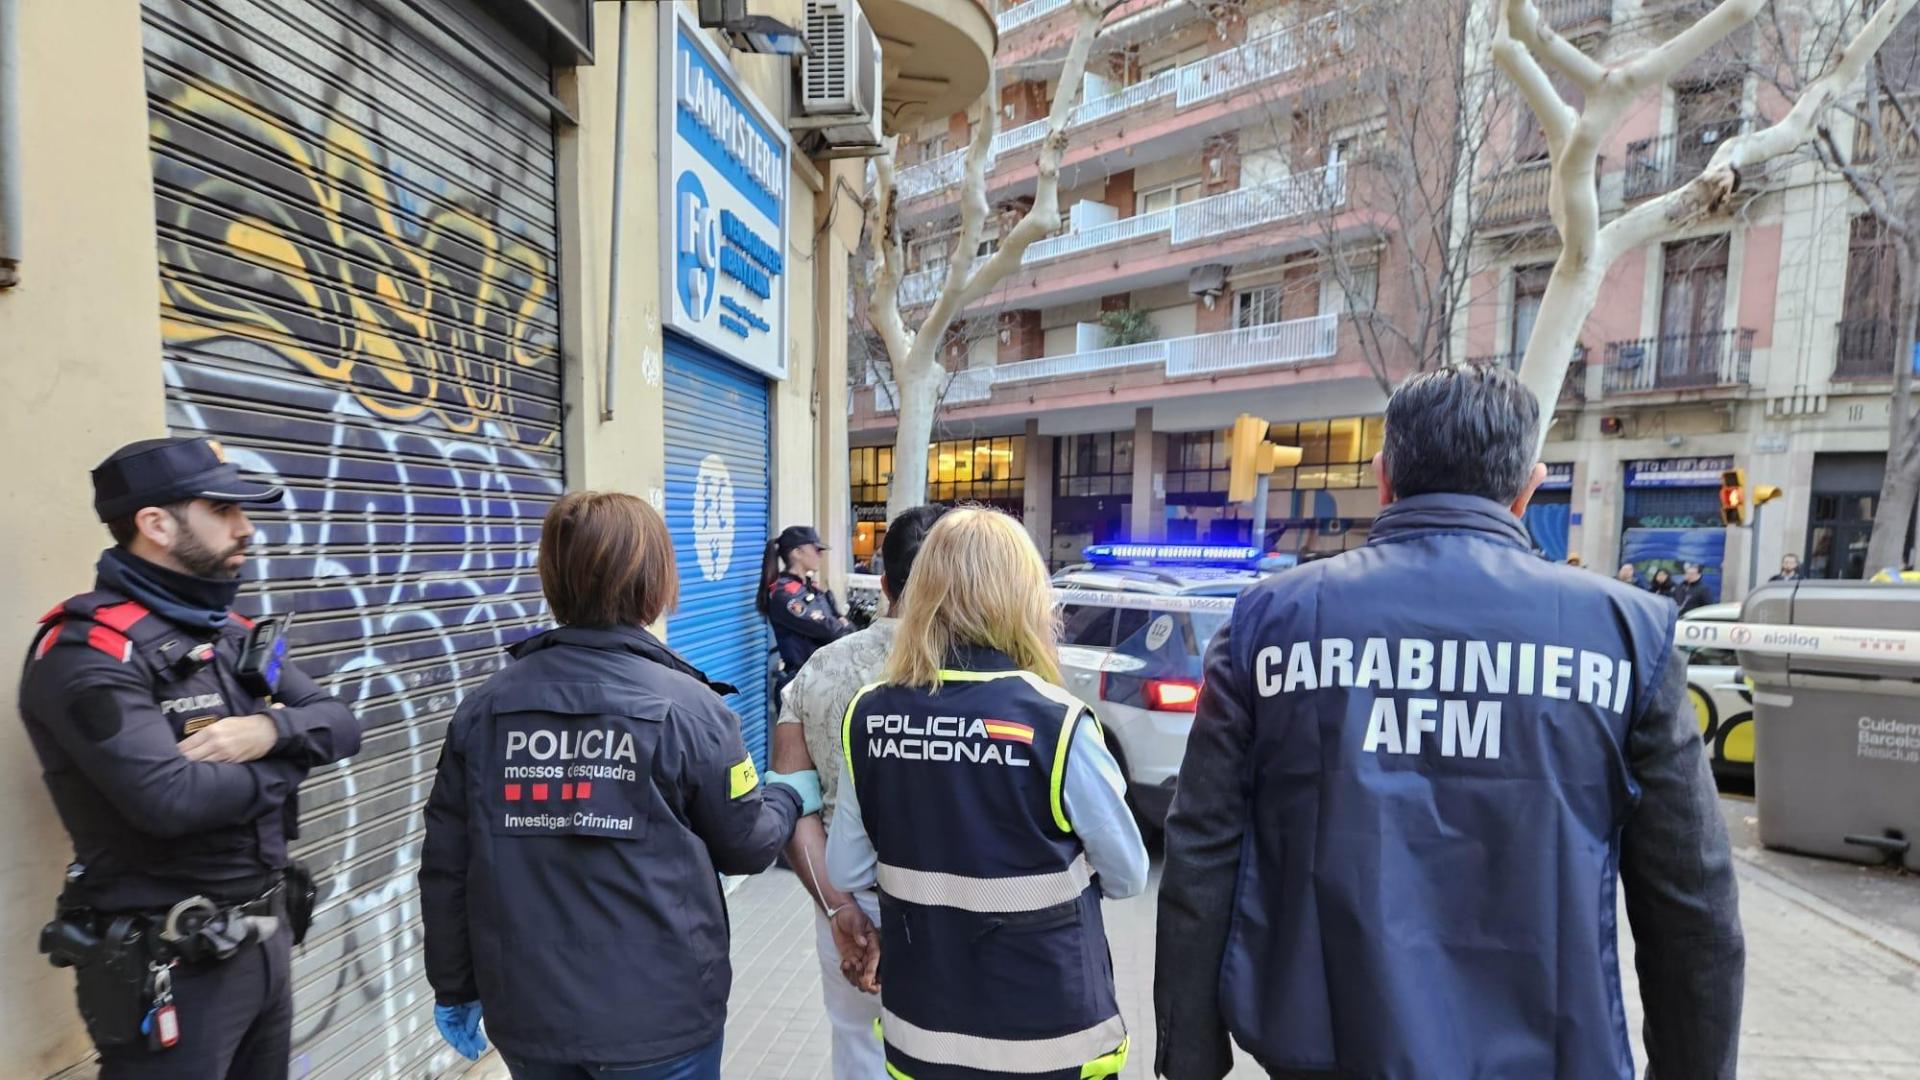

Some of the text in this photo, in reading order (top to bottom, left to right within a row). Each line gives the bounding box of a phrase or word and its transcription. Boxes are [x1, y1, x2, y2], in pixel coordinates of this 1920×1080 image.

[680, 50, 784, 200] LAMPISTERIA
[1151, 623, 1168, 637] 112
[1256, 638, 1631, 714] CARABINIERI
[1363, 697, 1502, 759] AFM
[505, 729, 637, 764] POLICIA
[868, 738, 1030, 767] NACIONAL
[504, 765, 564, 779] mossos
[573, 811, 633, 831] Criminal
